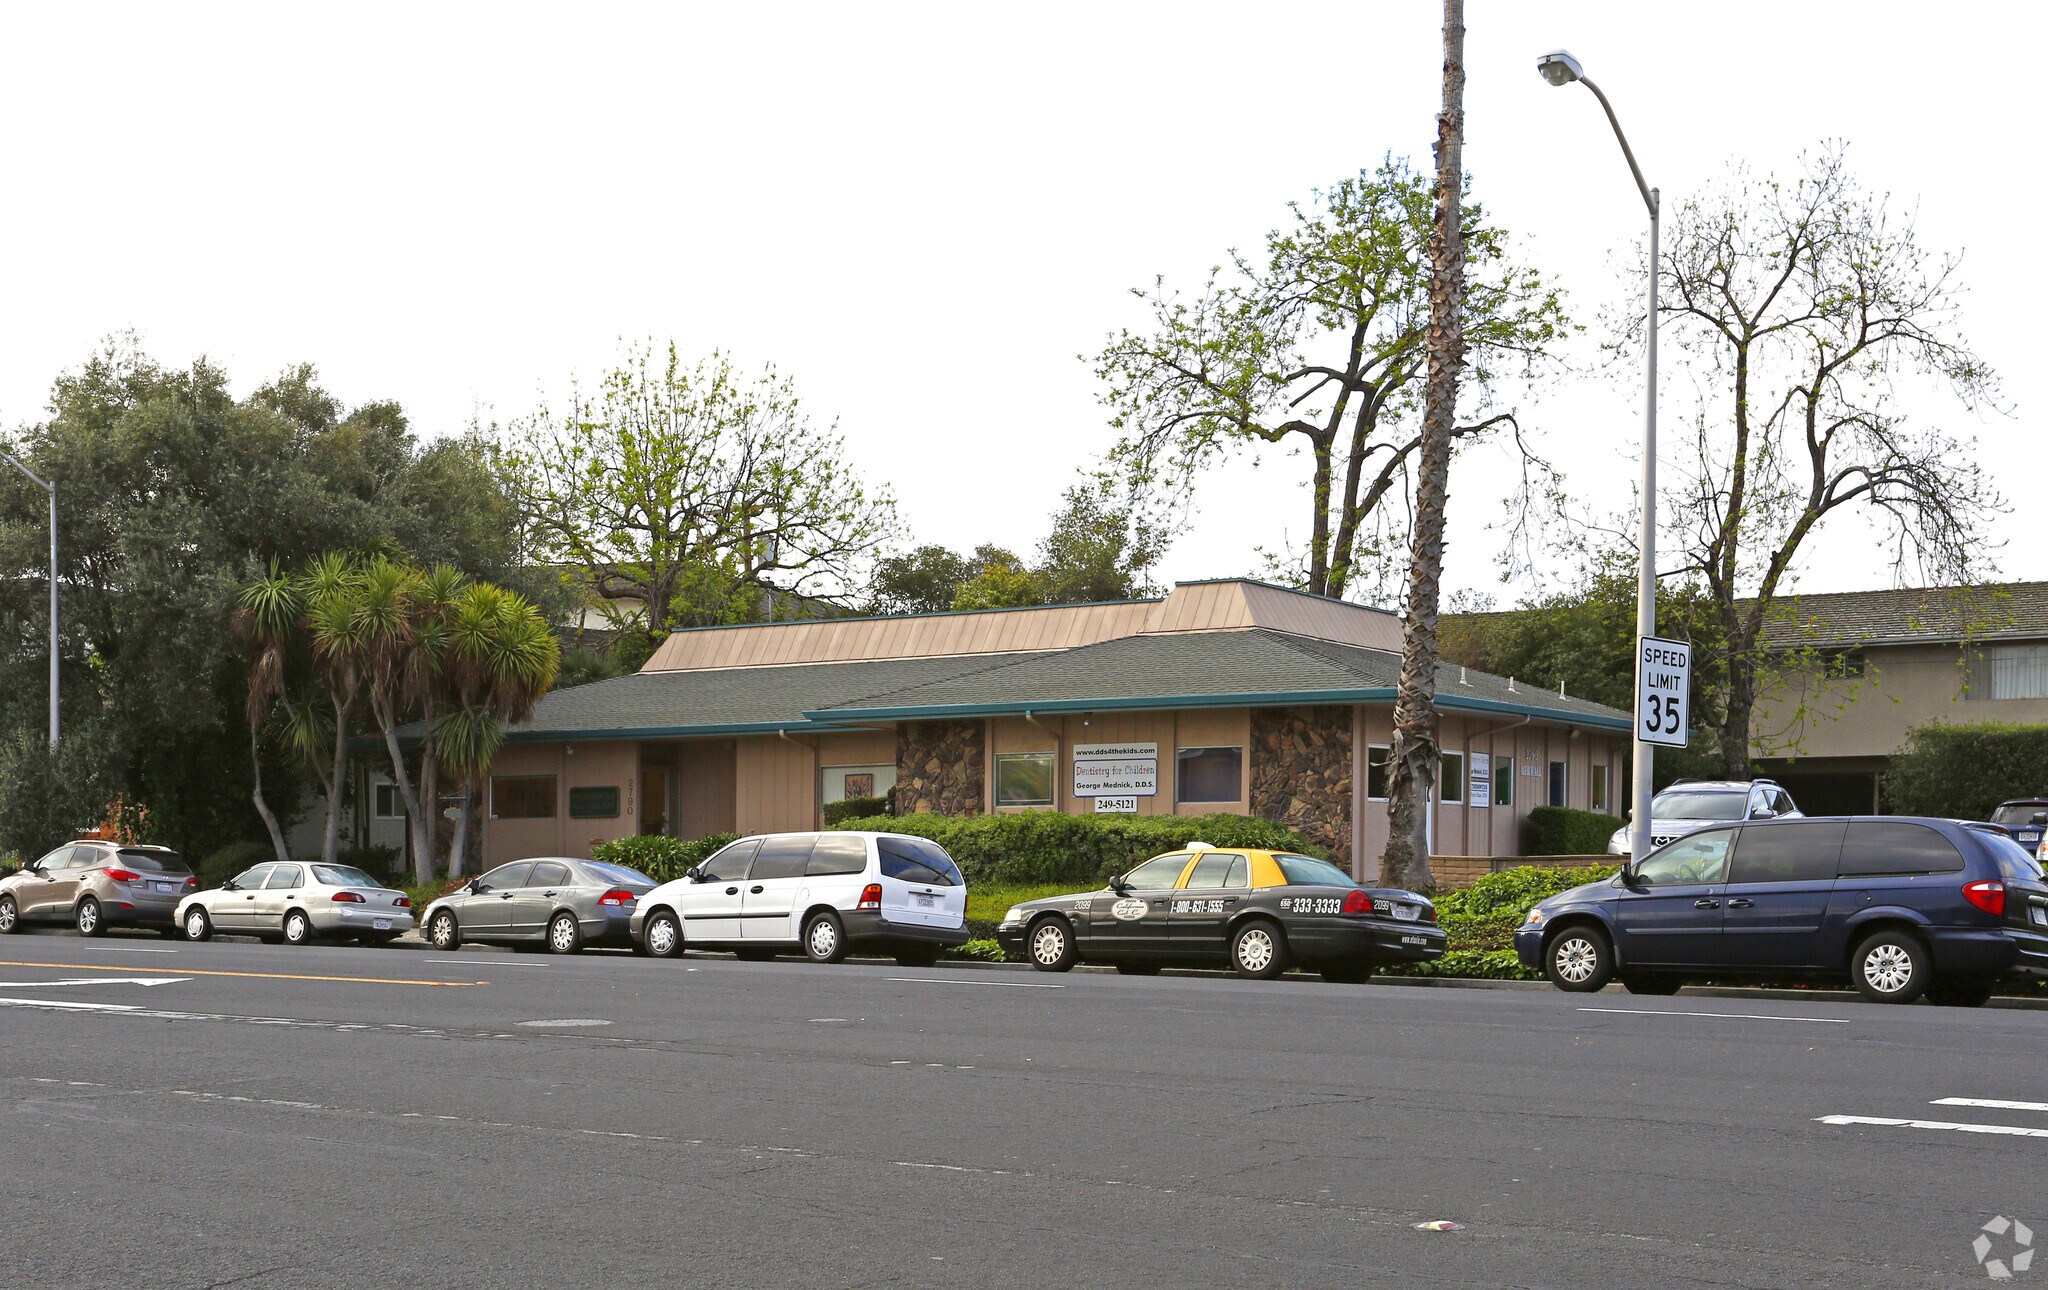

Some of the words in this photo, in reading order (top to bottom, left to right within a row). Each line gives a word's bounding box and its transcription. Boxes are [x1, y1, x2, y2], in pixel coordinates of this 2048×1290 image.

[1645, 648, 1686, 668] SPEED
[1648, 672, 1681, 691] LIMIT
[1646, 694, 1680, 735] 35
[1075, 748, 1155, 756] www.dds4thekids.com
[1076, 766, 1110, 778] Dentistry
[1112, 765, 1122, 776] for
[1124, 765, 1155, 775] Children
[1076, 782, 1101, 790] George
[1103, 781, 1133, 789] Mednick,
[626, 778, 634, 815] 2790
[1098, 799, 1134, 810] 249-5121
[1074, 900, 1091, 910] 2099
[1170, 900, 1225, 913] 1-800-631-1555
[1292, 897, 1341, 914] 333-3333
[1373, 899, 1389, 911] 2099
